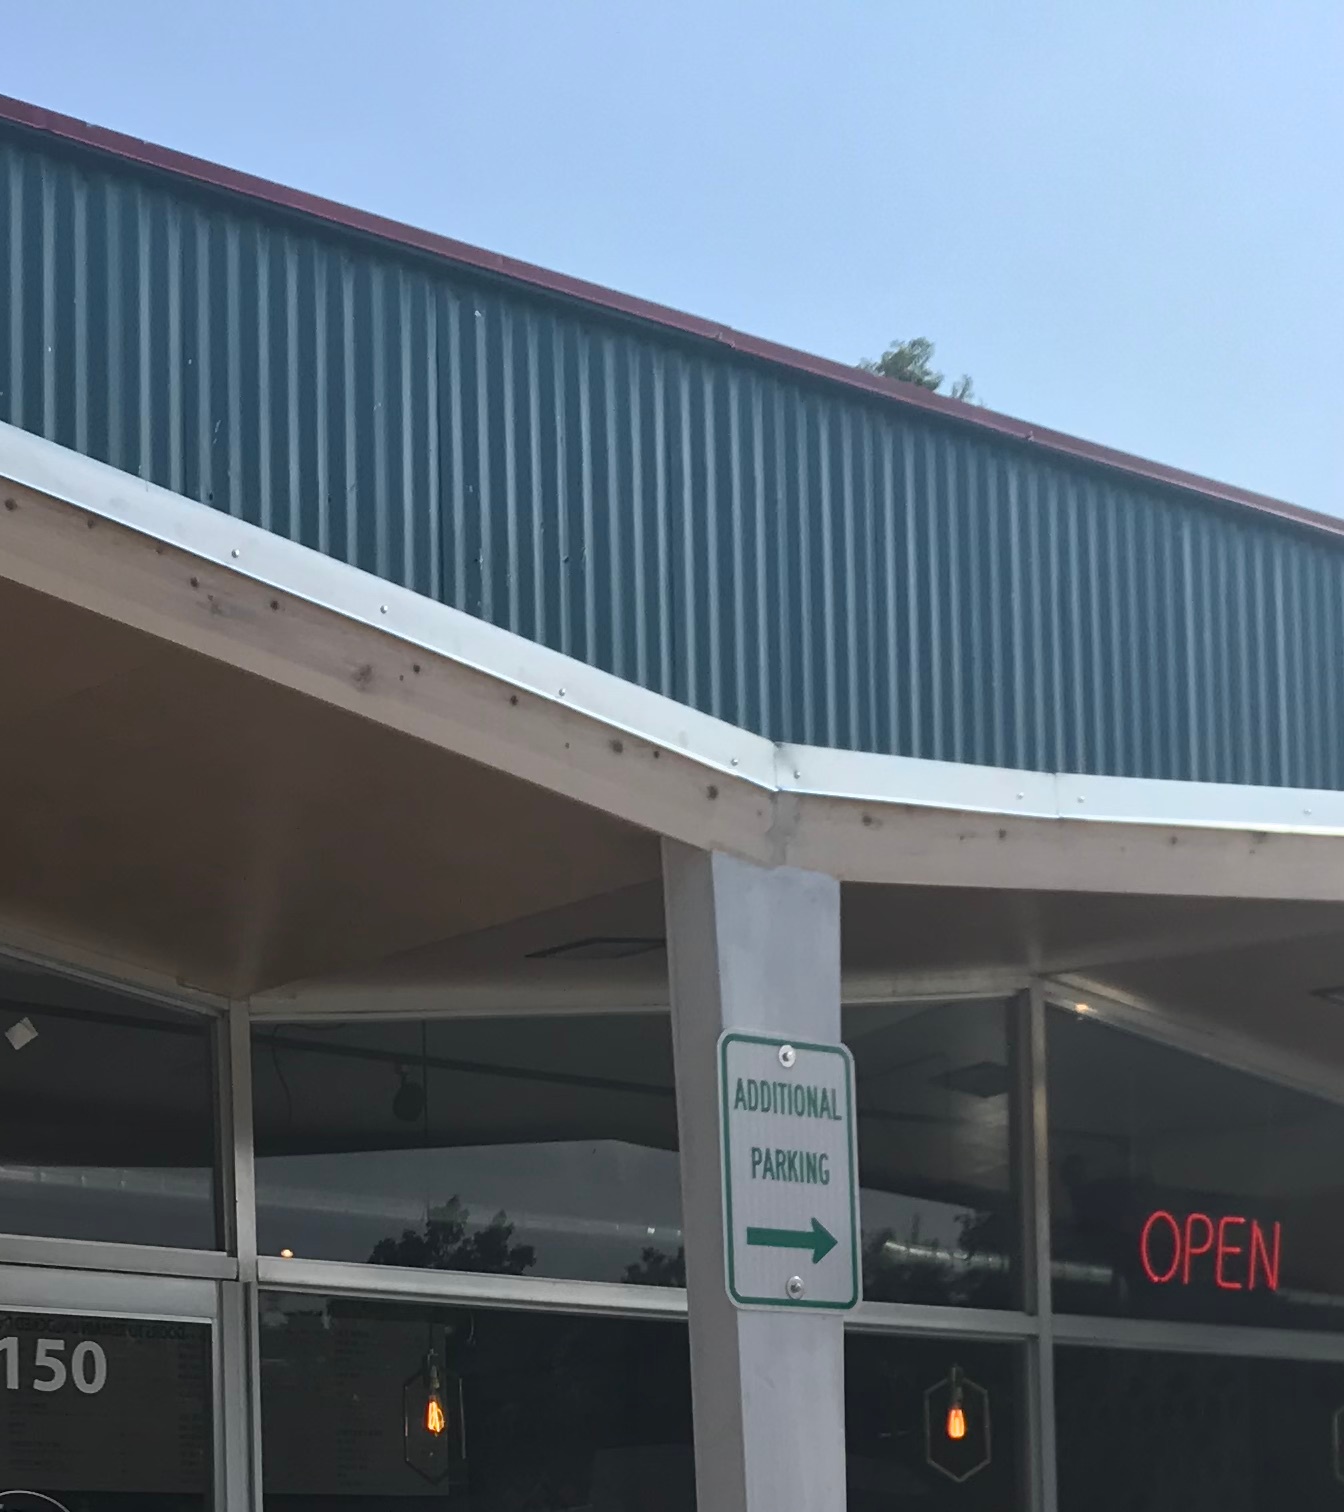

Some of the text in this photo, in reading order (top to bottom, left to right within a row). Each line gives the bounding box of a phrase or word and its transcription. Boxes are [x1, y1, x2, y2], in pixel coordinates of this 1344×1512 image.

[733, 1077, 843, 1121] ADDITIONAL
[751, 1147, 830, 1186] PARKING
[1139, 1209, 1281, 1291] OPEN
